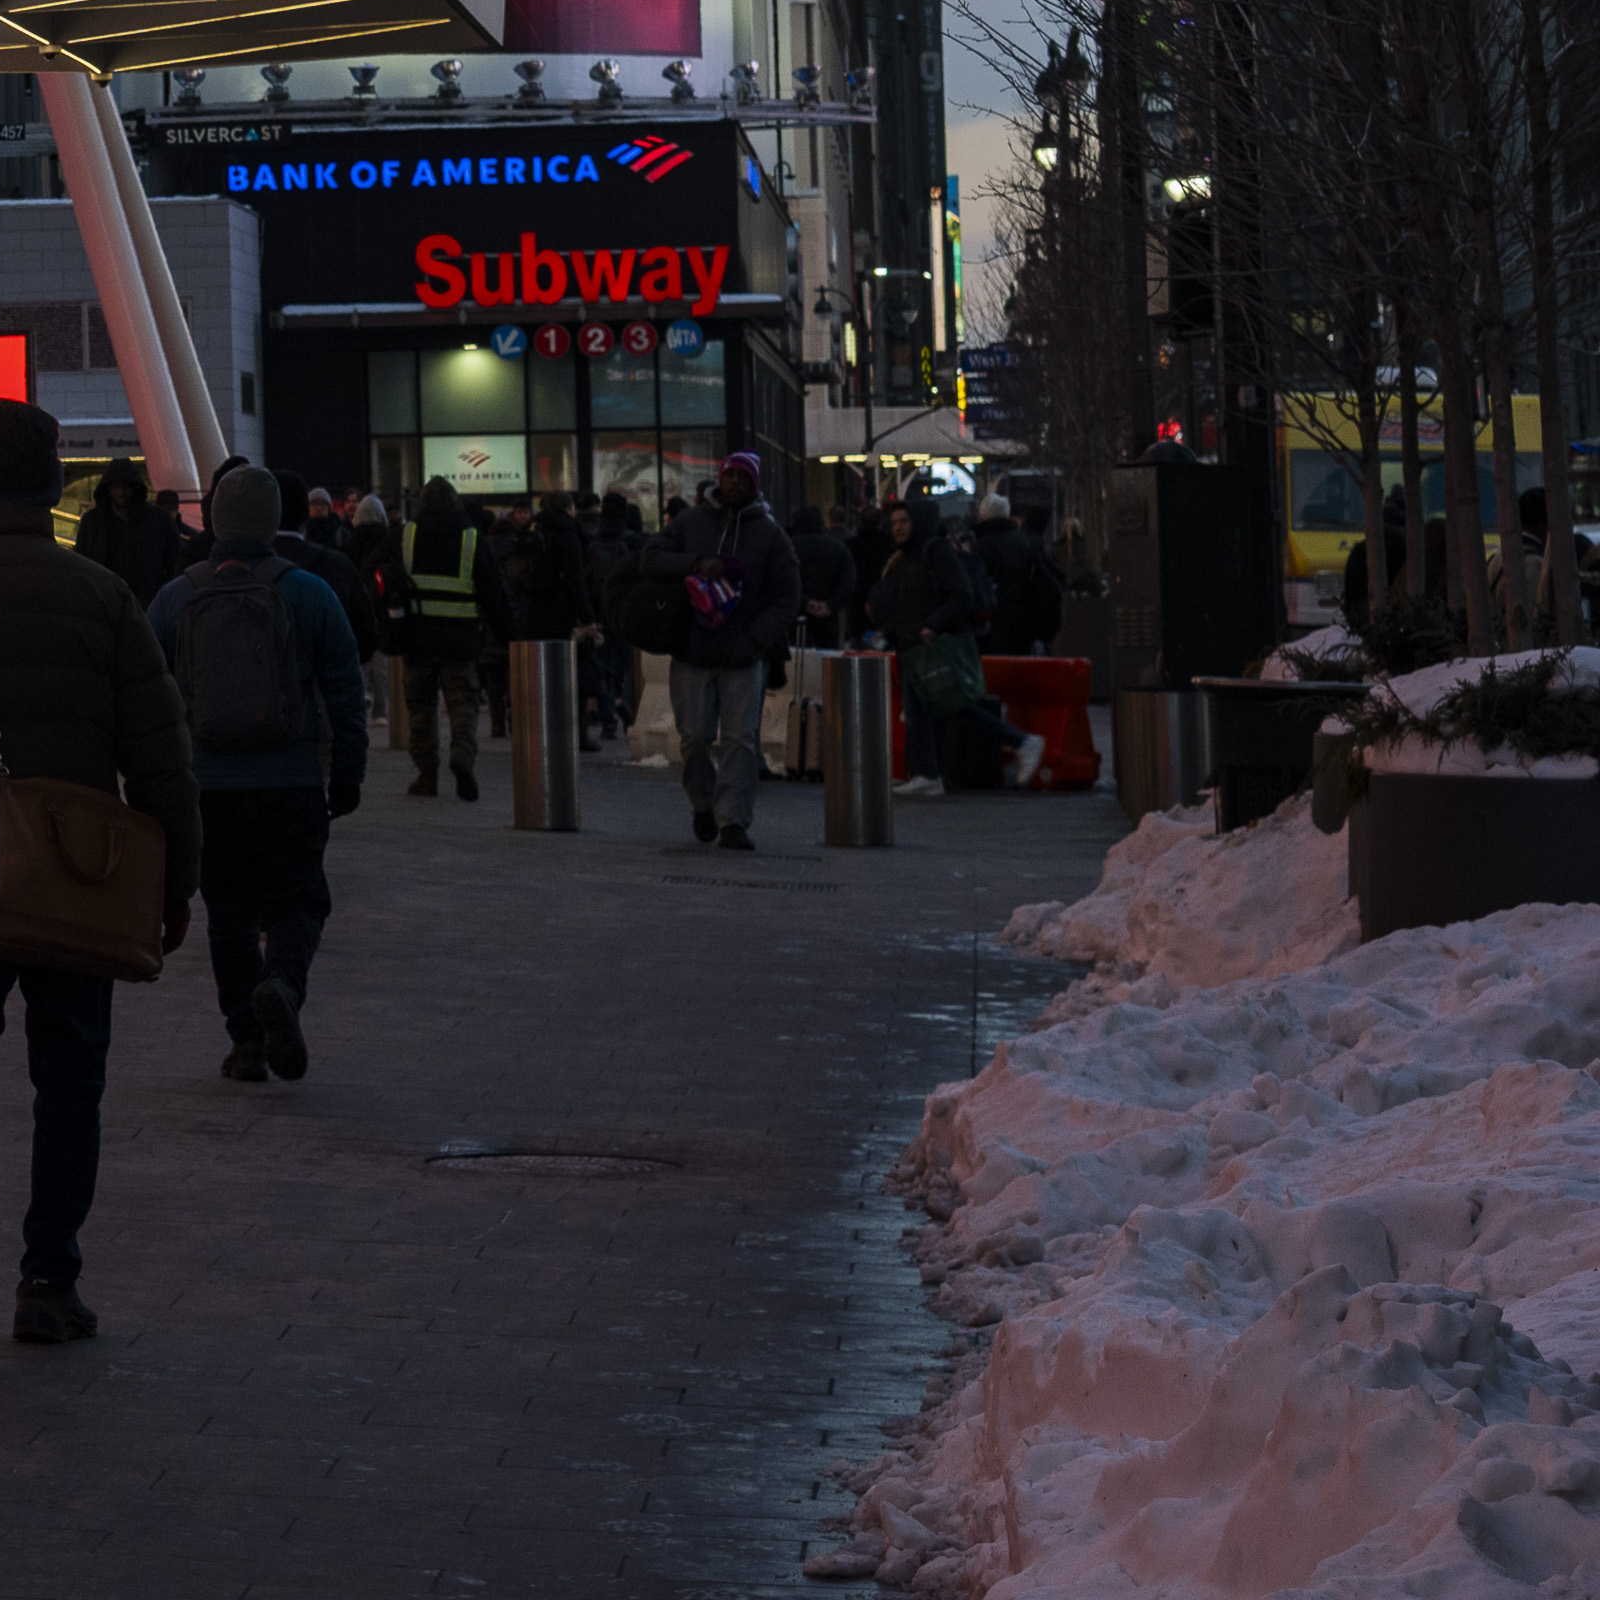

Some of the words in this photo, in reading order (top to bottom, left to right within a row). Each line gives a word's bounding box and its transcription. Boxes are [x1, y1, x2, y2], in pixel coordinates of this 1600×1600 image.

[227, 160, 340, 191] BANK
[350, 158, 402, 189] OF
[411, 153, 600, 187] AMERICA
[414, 232, 730, 317] Subway
[544, 327, 561, 353] 1
[586, 327, 606, 352] 2
[630, 326, 649, 351] 3
